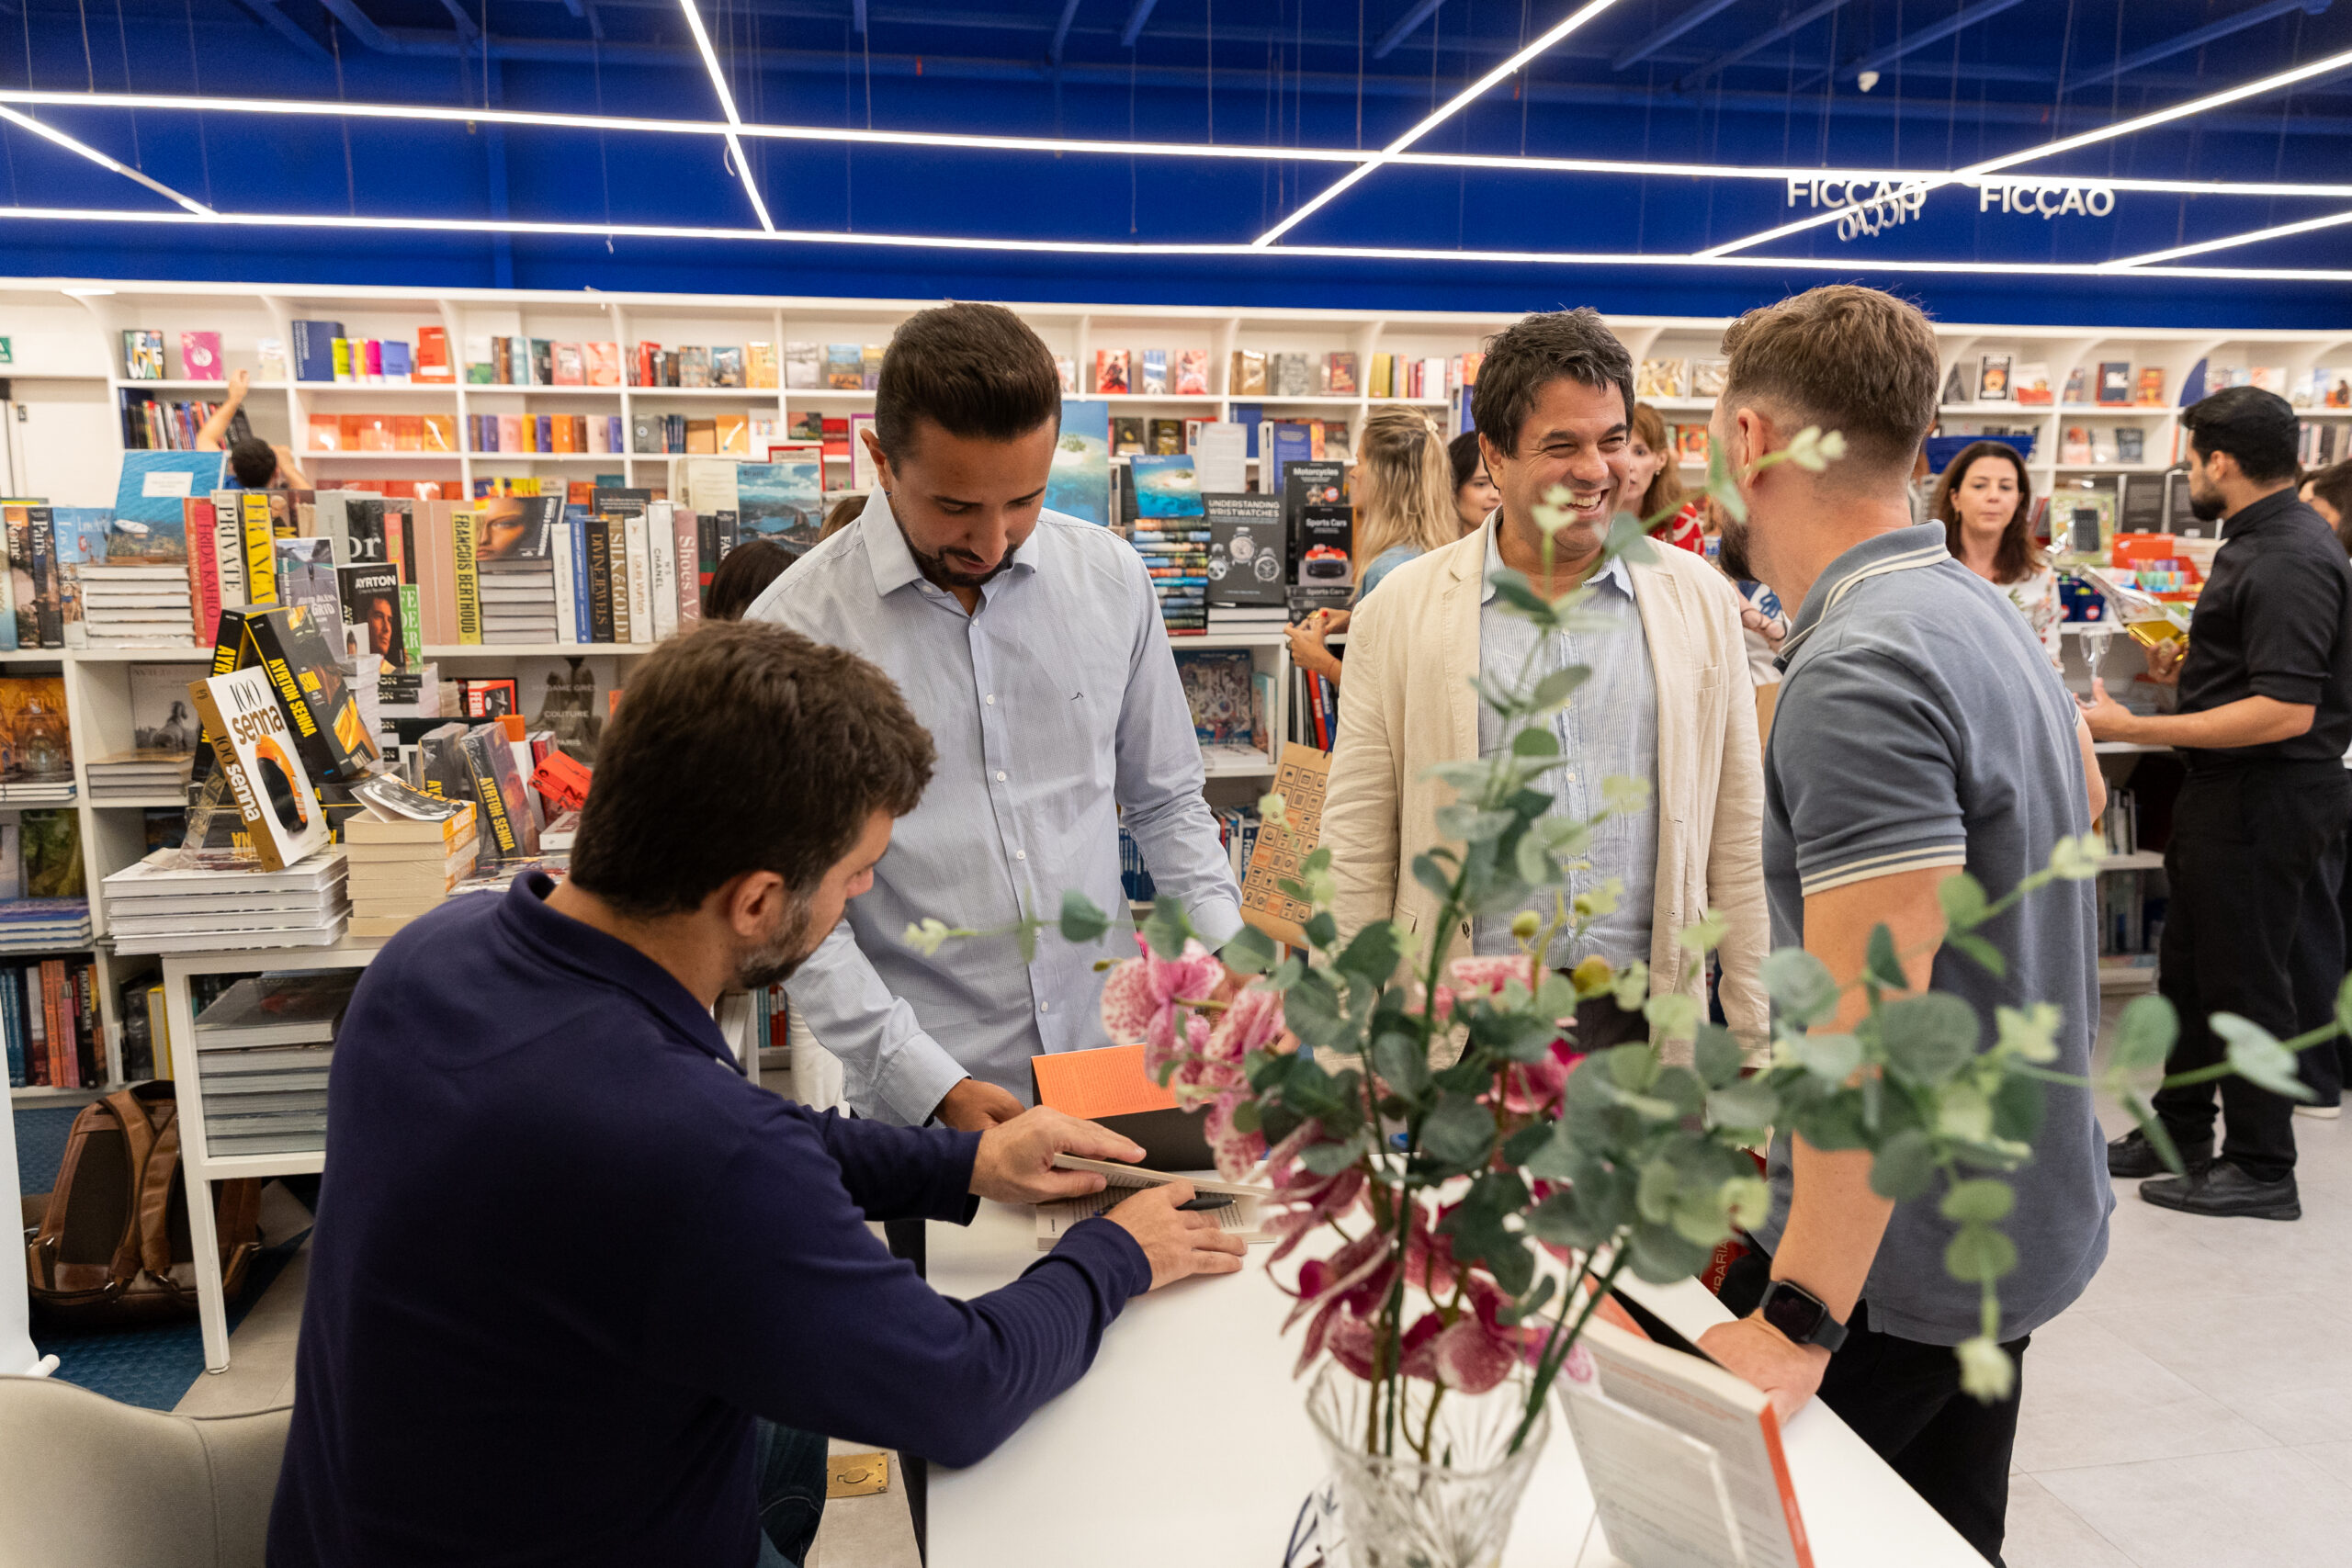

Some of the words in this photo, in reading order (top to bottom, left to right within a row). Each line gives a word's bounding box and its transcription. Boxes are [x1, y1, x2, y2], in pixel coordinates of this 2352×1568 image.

[1208, 500, 1281, 509] UNDERSTANDING
[1208, 508, 1280, 517] WRISTWATCHES
[6, 521, 22, 560] Rome
[32, 521, 49, 557] Paris
[198, 524, 216, 565] FRIDA
[219, 506, 242, 592] PRIVATE
[610, 533, 626, 571] SILK
[355, 575, 397, 590] AYRTON
[613, 573, 627, 583] &
[654, 548, 663, 589] CHANEL
[679, 536, 695, 591] Shoes
[202, 570, 220, 618] KAHLO
[311, 604, 335, 617] GRID
[458, 574, 477, 634] BERTHOUD
[613, 585, 629, 632] GOLD
[230, 679, 263, 713] 100
[268, 658, 300, 702] AYRTON
[289, 700, 318, 739] SENNA
[543, 710, 590, 718] COUTURE
[232, 705, 285, 746] senna
[213, 735, 238, 767] 100
[226, 763, 261, 822] senna
[479, 777, 503, 815] AYRTON
[493, 816, 515, 852] SENNA
